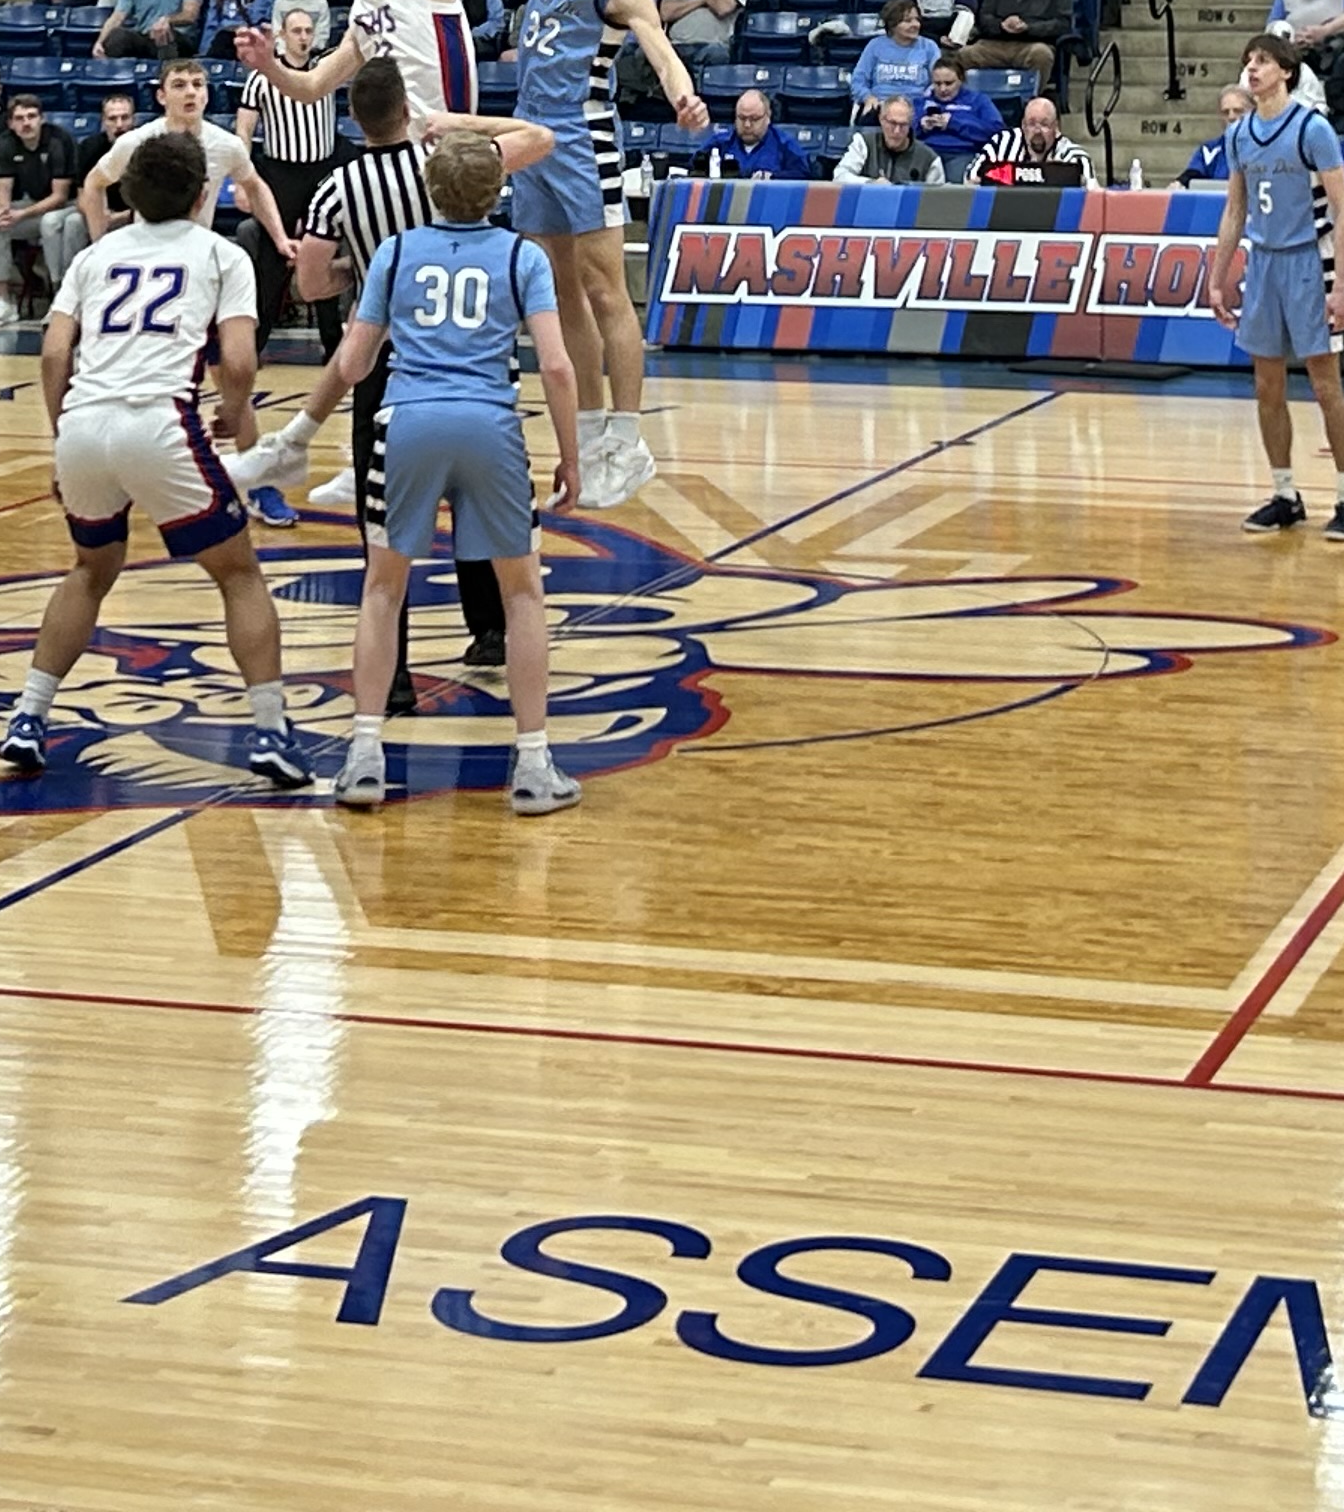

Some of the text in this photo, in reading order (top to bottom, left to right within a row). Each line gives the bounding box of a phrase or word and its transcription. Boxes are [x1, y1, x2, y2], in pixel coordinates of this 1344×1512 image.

[523, 9, 561, 56] 32
[1176, 63, 1196, 77] OW
[1141, 120, 1167, 134] ROW
[1258, 180, 1274, 215] 5
[670, 232, 1085, 304] NASHVILLE
[100, 265, 185, 336] 22
[414, 265, 490, 331] 30
